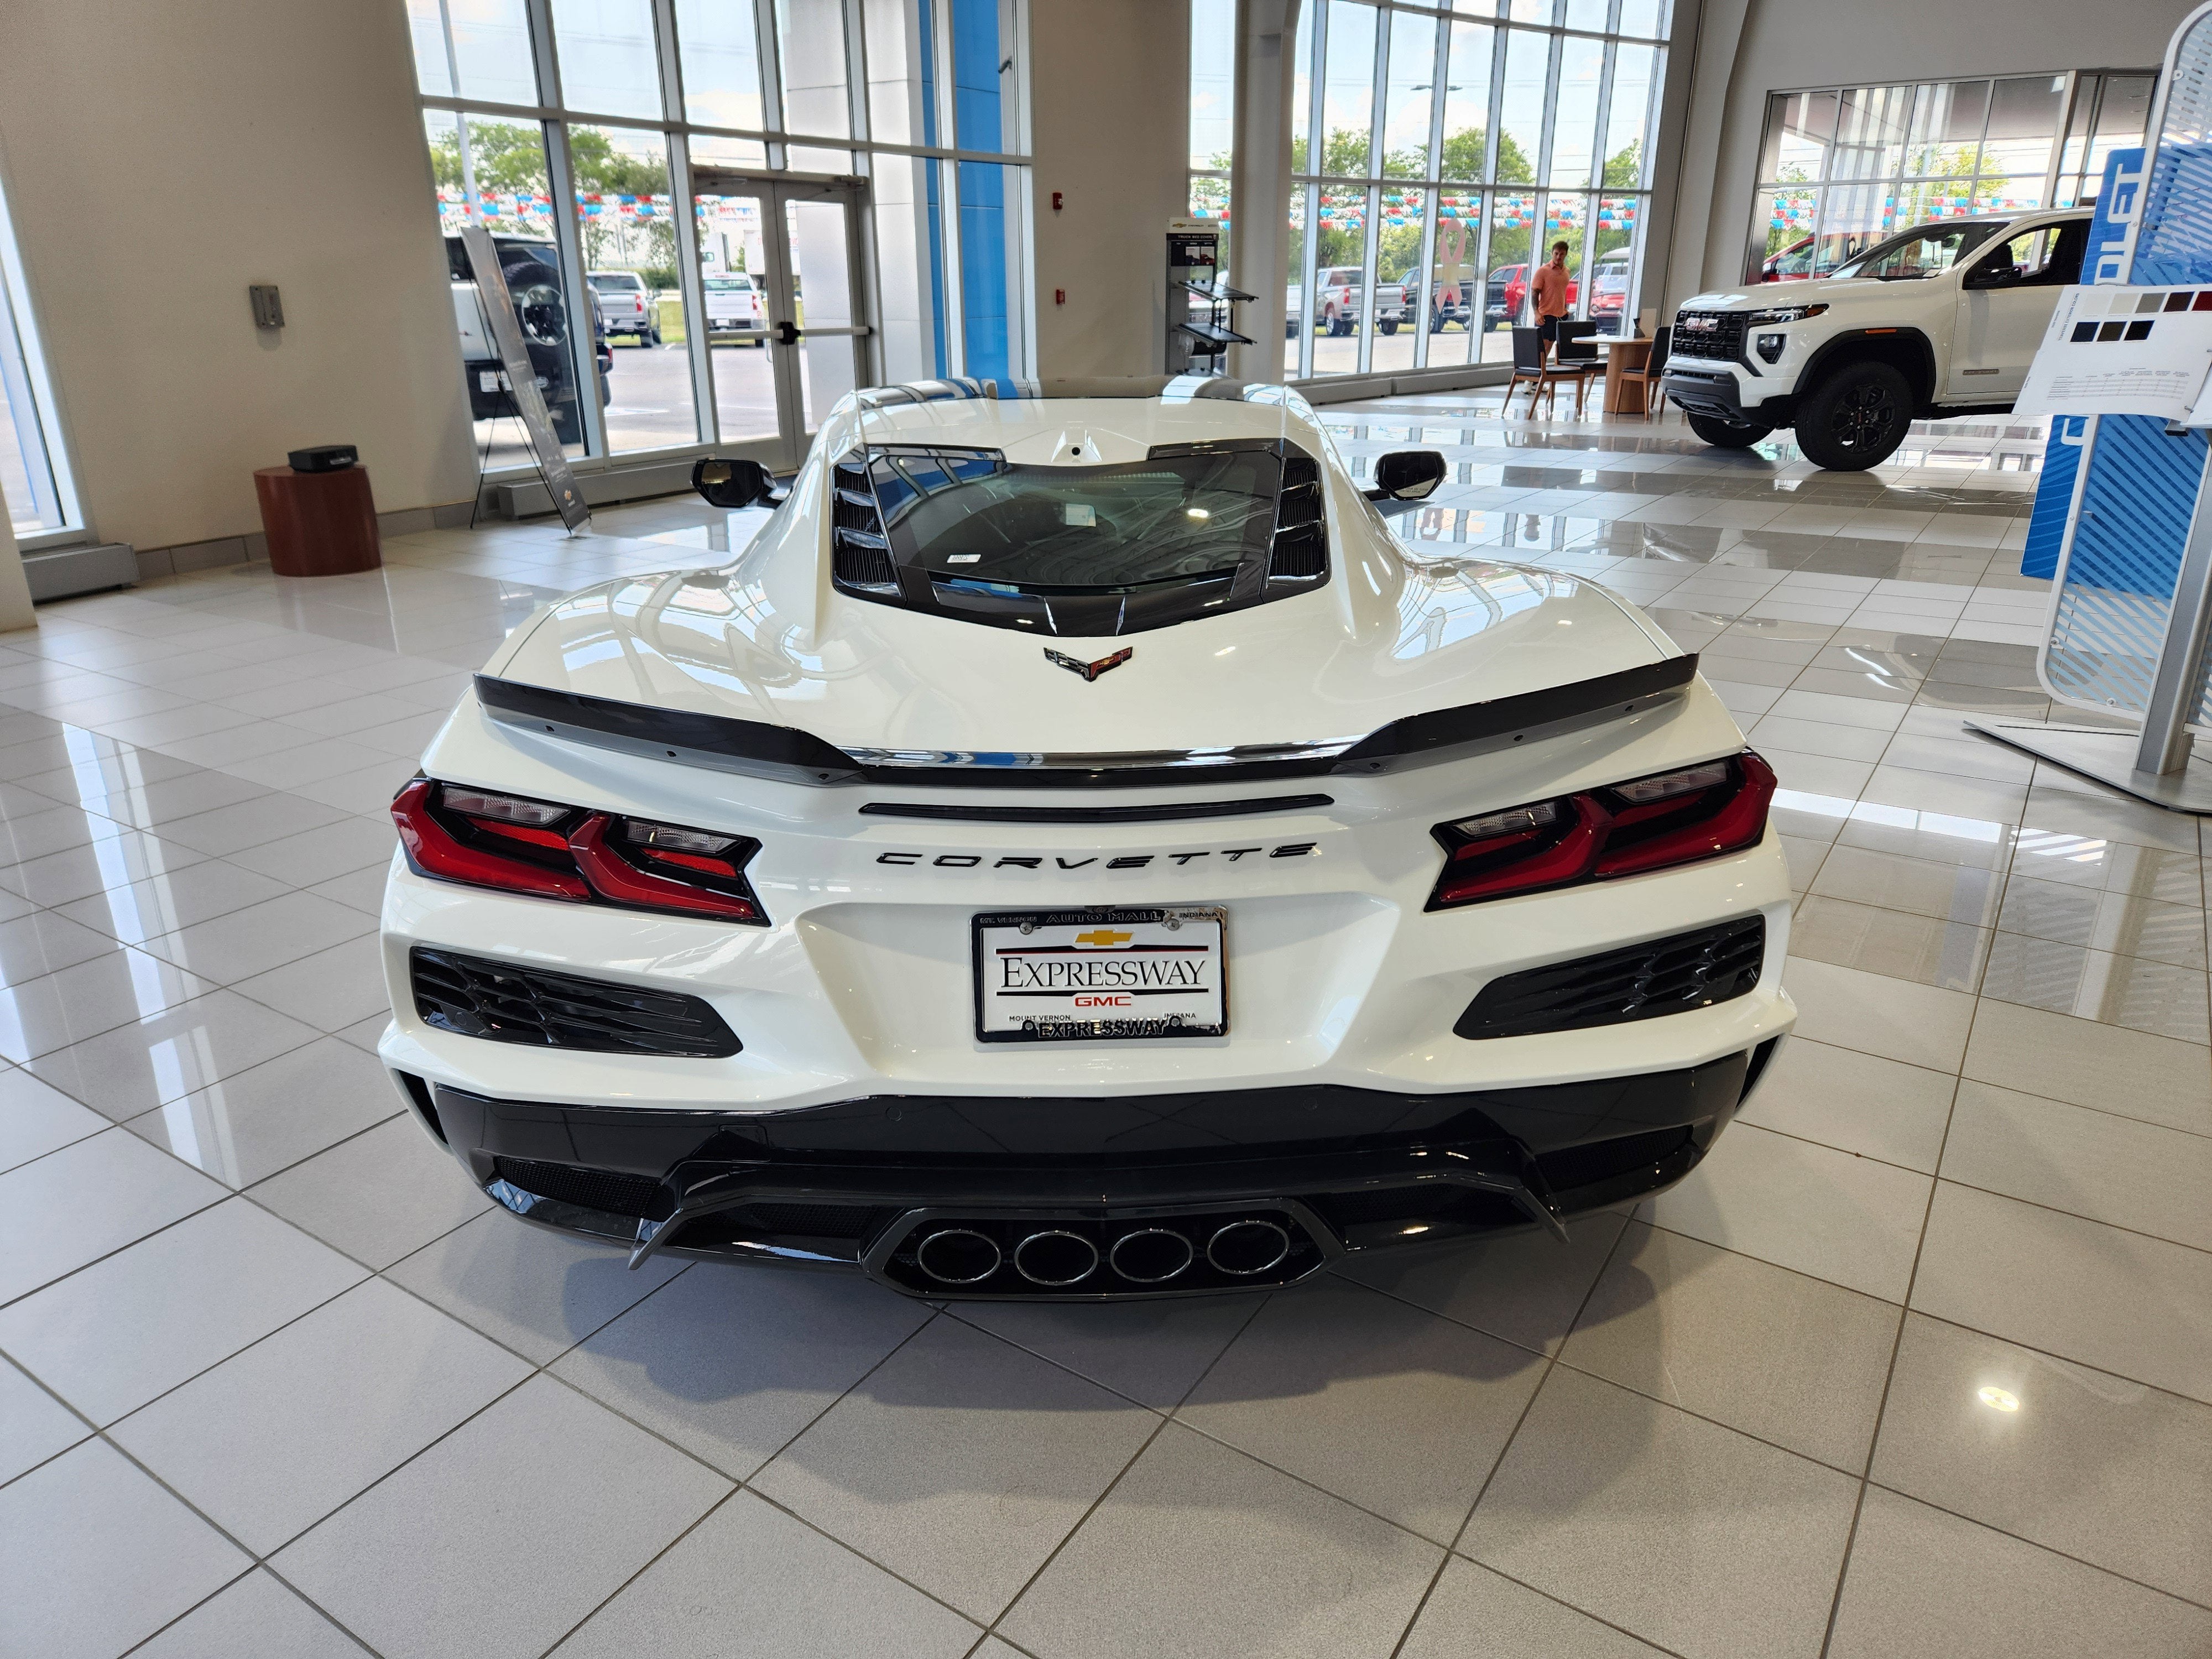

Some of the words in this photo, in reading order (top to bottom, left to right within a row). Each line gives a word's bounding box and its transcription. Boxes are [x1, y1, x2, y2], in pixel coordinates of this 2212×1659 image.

[1686, 318, 1719, 332] GMC
[876, 842, 1318, 870] CORVETTE
[1046, 912, 1103, 923] AUTO
[1108, 911, 1161, 922] MALL
[1074, 996, 1131, 1006] GMC
[1038, 1018, 1166, 1038] EXPRESSWAY
